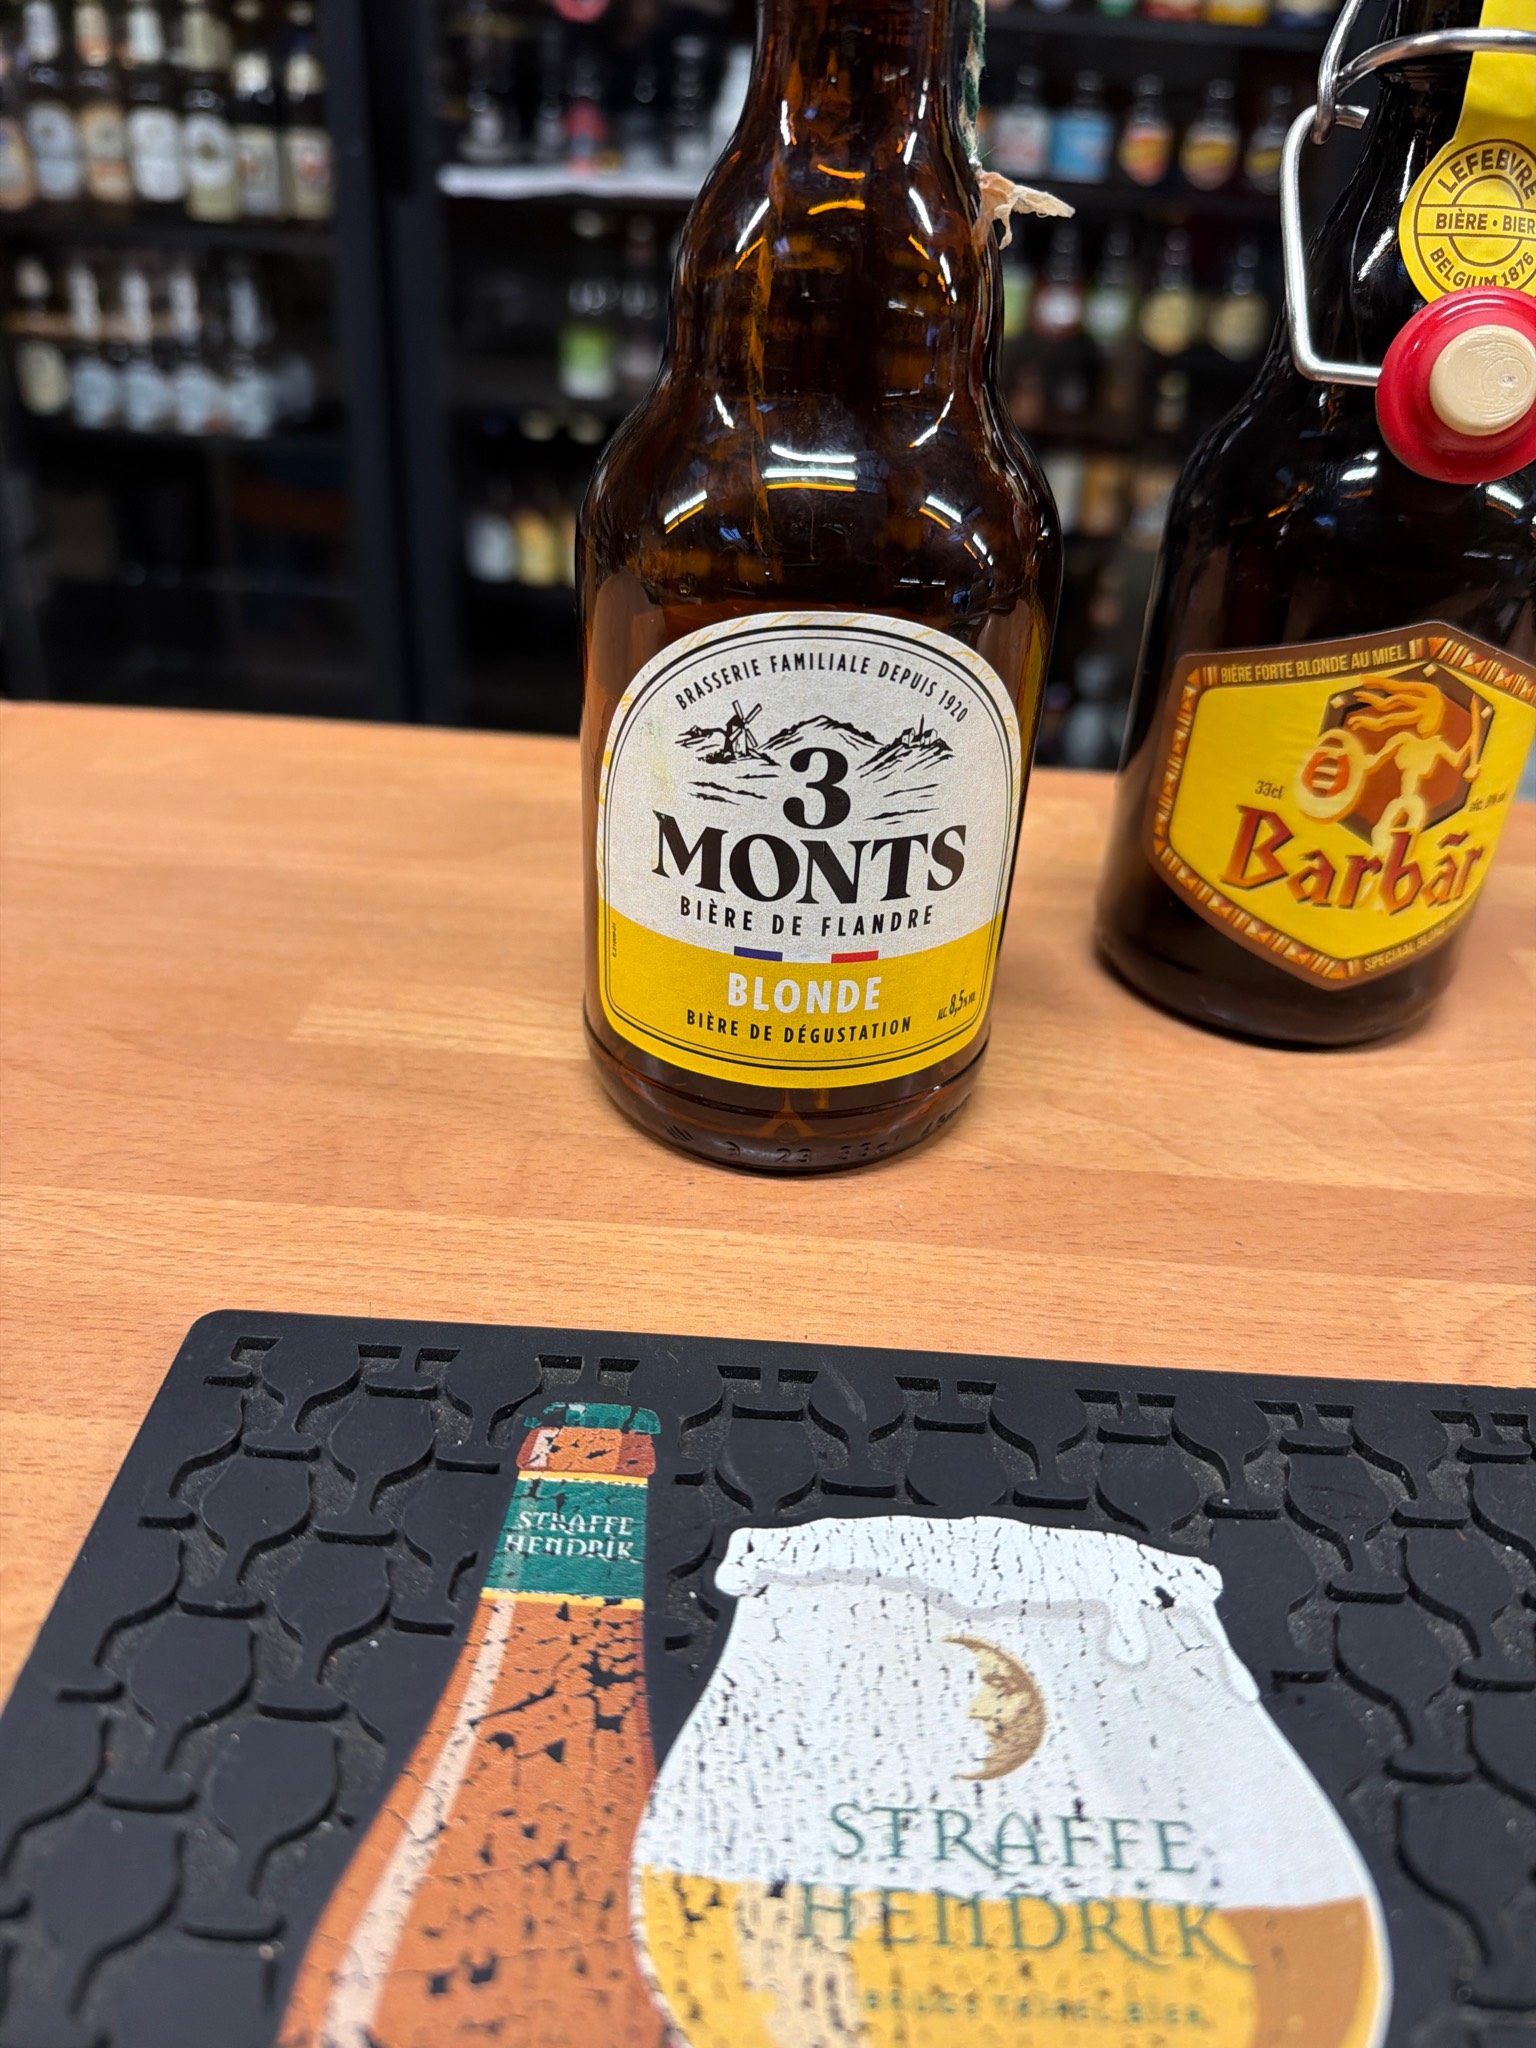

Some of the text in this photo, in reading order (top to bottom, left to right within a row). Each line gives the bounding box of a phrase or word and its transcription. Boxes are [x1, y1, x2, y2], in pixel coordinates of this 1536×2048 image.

[1437, 148, 1536, 201] LEFEBVRE
[1435, 208, 1536, 236] BIÈRE BIER
[1429, 246, 1534, 288] BELGIUM 1876
[1220, 644, 1406, 684] BIÈRE FORTE BLONDE AU MIEL
[674, 652, 969, 724] BRASSERIE FAMILIALE DEPUIS 1920
[782, 746, 852, 830] 3
[1254, 779, 1284, 800] 33cl
[651, 809, 967, 905] MONTS
[680, 896, 934, 937] BIÈRE DE FLANDRE
[727, 971, 883, 1015] BLONDE
[686, 1009, 913, 1045] BIÈRE DE DÉGUSTATION
[518, 1510, 635, 1536] STRAFFE
[504, 1535, 646, 1564] HENDRIK
[829, 1803, 1197, 1877] STRAFFE
[799, 1882, 1257, 1972] HENDRIK
